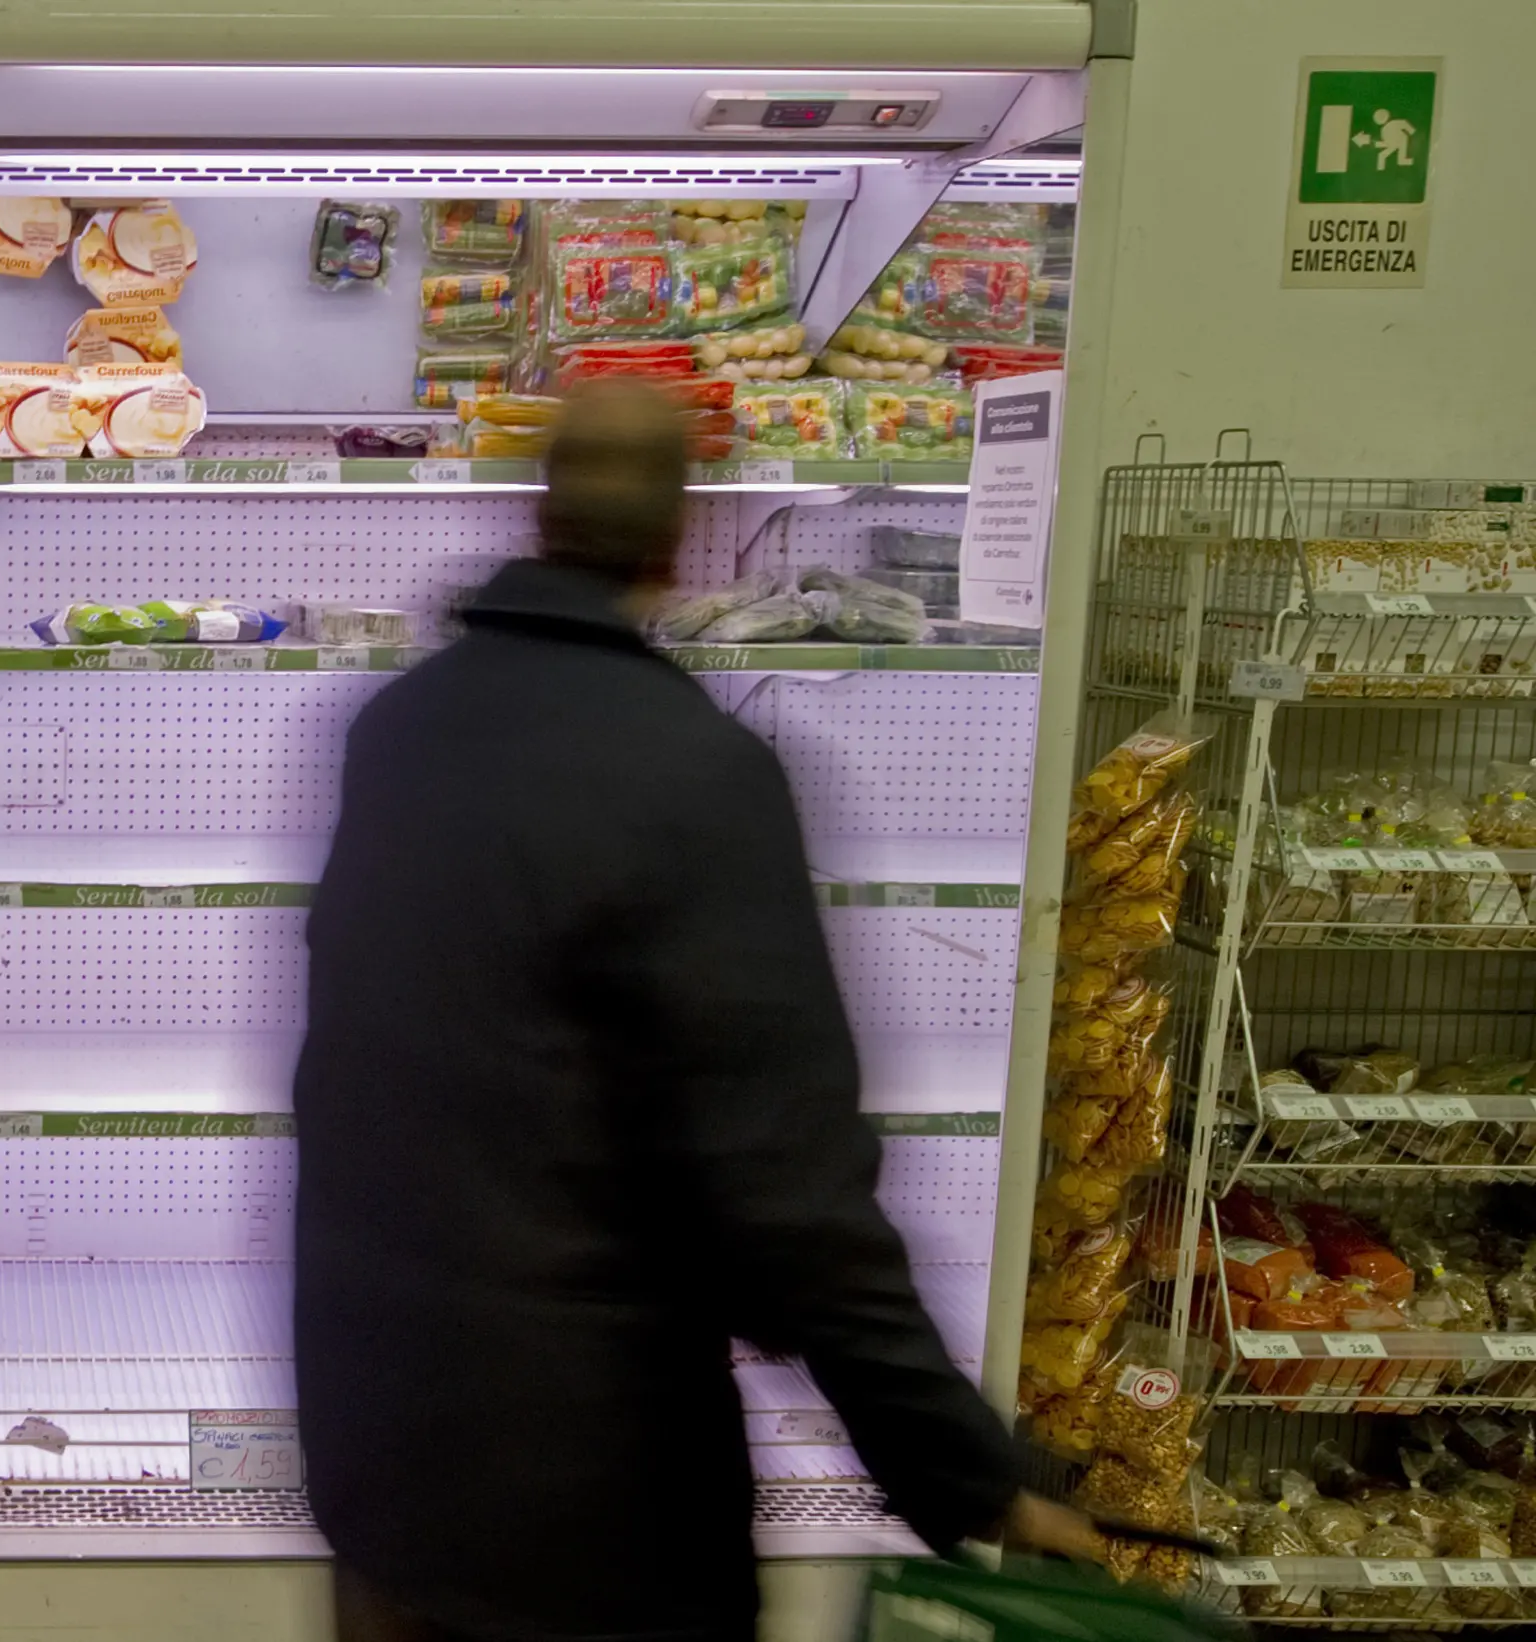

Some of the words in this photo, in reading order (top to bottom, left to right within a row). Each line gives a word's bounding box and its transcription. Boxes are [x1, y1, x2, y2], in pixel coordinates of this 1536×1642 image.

[1308, 219, 1380, 243] USCITA
[1386, 220, 1407, 243] DI
[1291, 249, 1417, 273] EMERGENZA
[97, 365, 164, 377] Carrefour
[202, 462, 236, 483] da
[703, 649, 750, 669] soli
[232, 886, 279, 905] soli
[75, 1115, 182, 1136] Servitevi
[191, 1115, 224, 1136] da
[230, 1447, 292, 1484] 1,59
